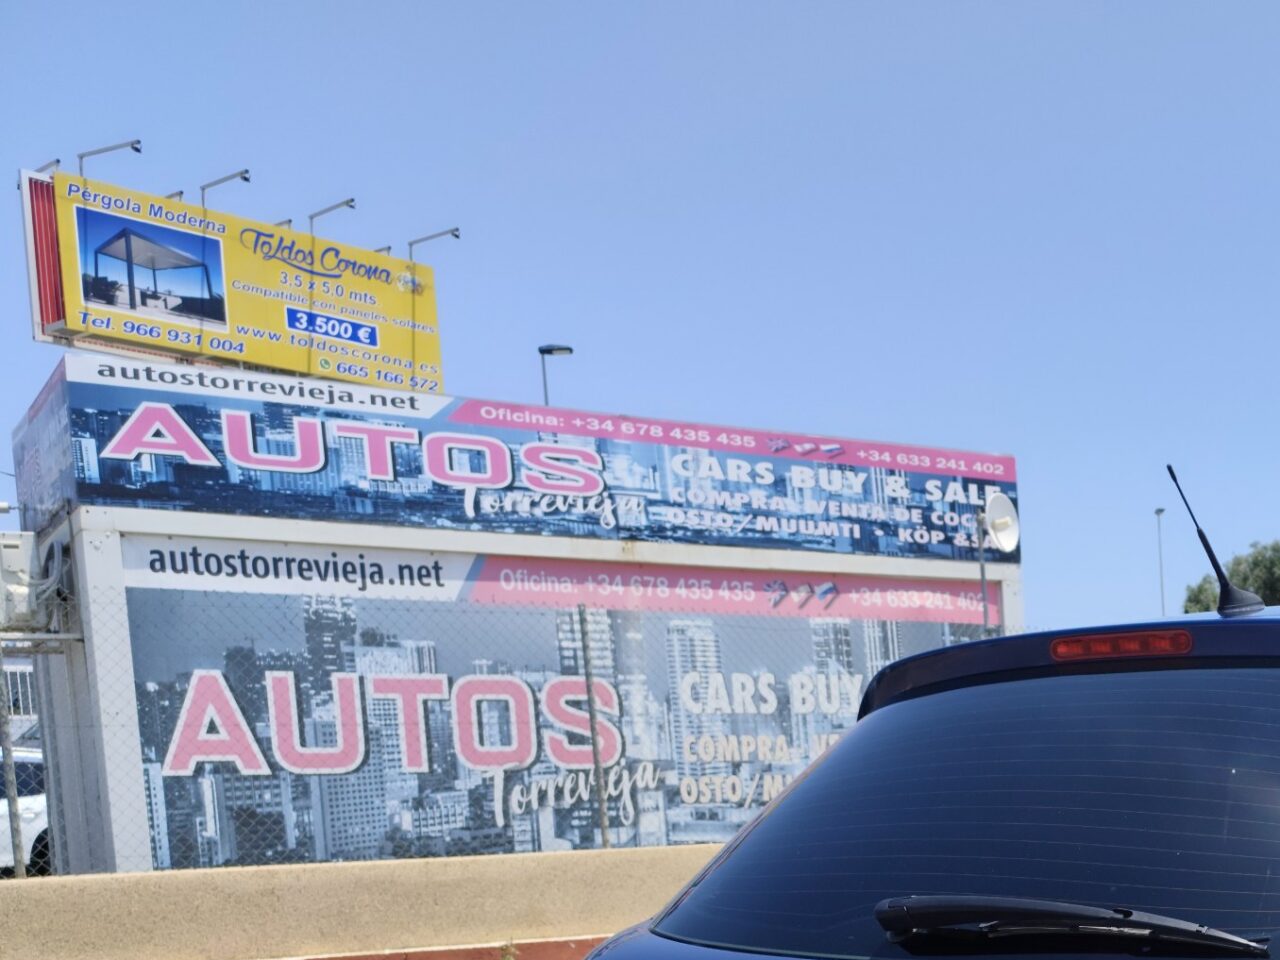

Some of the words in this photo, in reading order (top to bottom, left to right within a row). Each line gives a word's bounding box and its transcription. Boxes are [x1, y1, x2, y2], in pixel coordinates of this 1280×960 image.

[67, 183, 141, 213] Pérgola
[148, 203, 226, 234] Moderna
[240, 228, 316, 272] Toldos
[320, 247, 392, 284] Corona
[231, 279, 308, 305] Compatible
[312, 301, 336, 312] con
[340, 306, 388, 324] paneles
[392, 316, 435, 334] solares
[307, 281, 315, 291] x
[79, 311, 116, 330] Tel.
[123, 320, 161, 338] 966
[167, 329, 203, 346] 931
[209, 337, 245, 354] 004
[295, 312, 352, 339] 3.500
[357, 327, 371, 343] €
[98, 361, 421, 411] autostorrevieja.net
[336, 361, 369, 379] 665
[375, 368, 404, 385] 166
[409, 376, 439, 392] 572
[100, 401, 604, 495] AUTOS
[480, 406, 565, 428] Oficina:
[572, 417, 614, 433] +34
[620, 422, 663, 438] 678
[669, 426, 711, 443] 435
[716, 431, 756, 448] 435
[671, 453, 776, 485] CARS
[790, 465, 868, 495] BUY
[885, 476, 911, 499] &
[856, 449, 892, 463] +34
[896, 453, 931, 468] 633
[936, 457, 969, 471] 241
[972, 461, 1005, 475] 402
[896, 507, 923, 524] DE
[898, 525, 945, 545] KÖP
[149, 547, 446, 592] autostorrevieja.net
[500, 569, 578, 593] Oficina:
[584, 574, 624, 596] +34
[629, 575, 670, 598] 678
[675, 578, 713, 600] 435
[718, 580, 756, 602] 435
[849, 587, 883, 607] +34
[887, 589, 921, 609] 633
[924, 591, 954, 610] 241
[680, 672, 778, 715] CARS
[789, 672, 863, 715] BUY
[162, 669, 624, 776] AUTOS
[683, 734, 792, 764] COMPRA
[480, 760, 662, 828] Torreveja
[680, 773, 798, 810] OSTO/M
